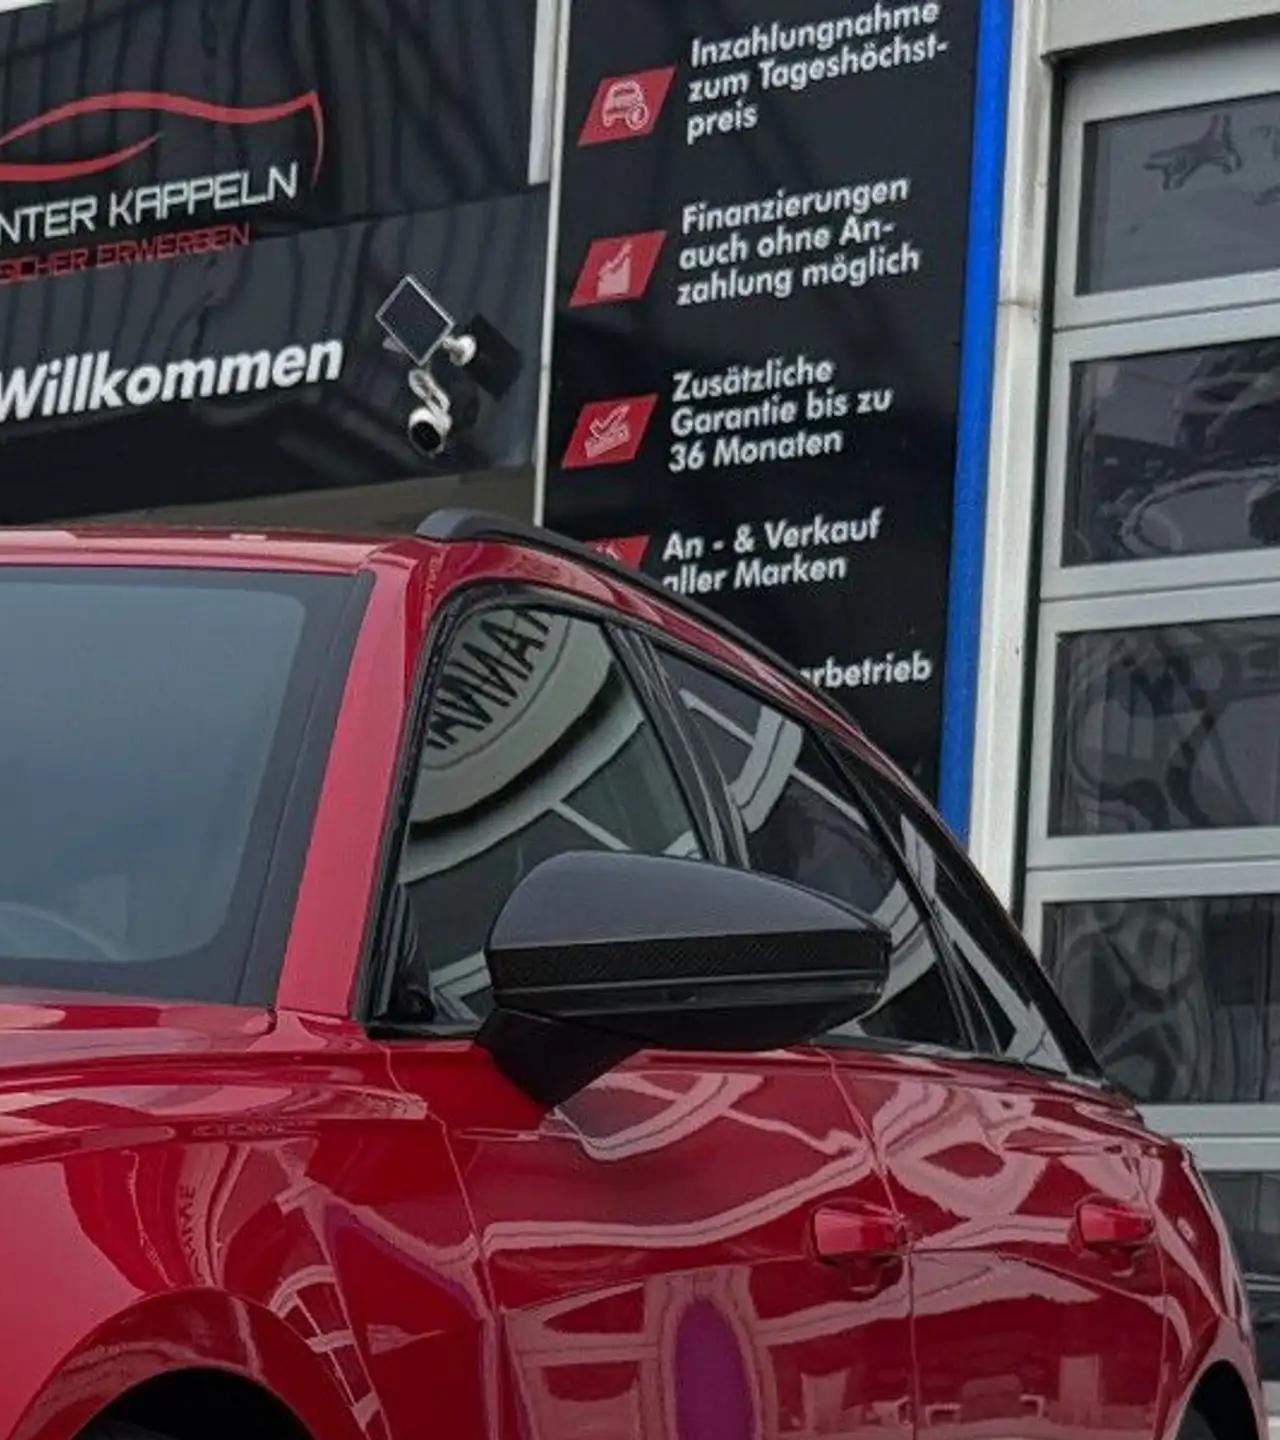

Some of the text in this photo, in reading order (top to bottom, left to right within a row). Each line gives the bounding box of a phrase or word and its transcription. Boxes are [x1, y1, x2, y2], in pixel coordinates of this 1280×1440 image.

[691, 1, 940, 68] Inzahlungnahme
[689, 30, 949, 102] zum Tageshöchst-
[687, 100, 758, 145] preis
[109, 162, 298, 228] KAPPELN
[682, 176, 911, 235] Finanzierungen
[97, 222, 250, 265] ERWERBEN
[679, 214, 896, 270] auch ohne An-
[676, 241, 920, 306] zahlung möglich
[672, 354, 836, 402] Zusätzliche
[670, 386, 894, 437] Garantie bis zu
[668, 430, 844, 474] 36 Monaten
[662, 530, 705, 562] An
[733, 523, 756, 554] &
[764, 505, 885, 550] Verkauf
[733, 552, 848, 590] Marken
[799, 650, 933, 689] rbetrieb
